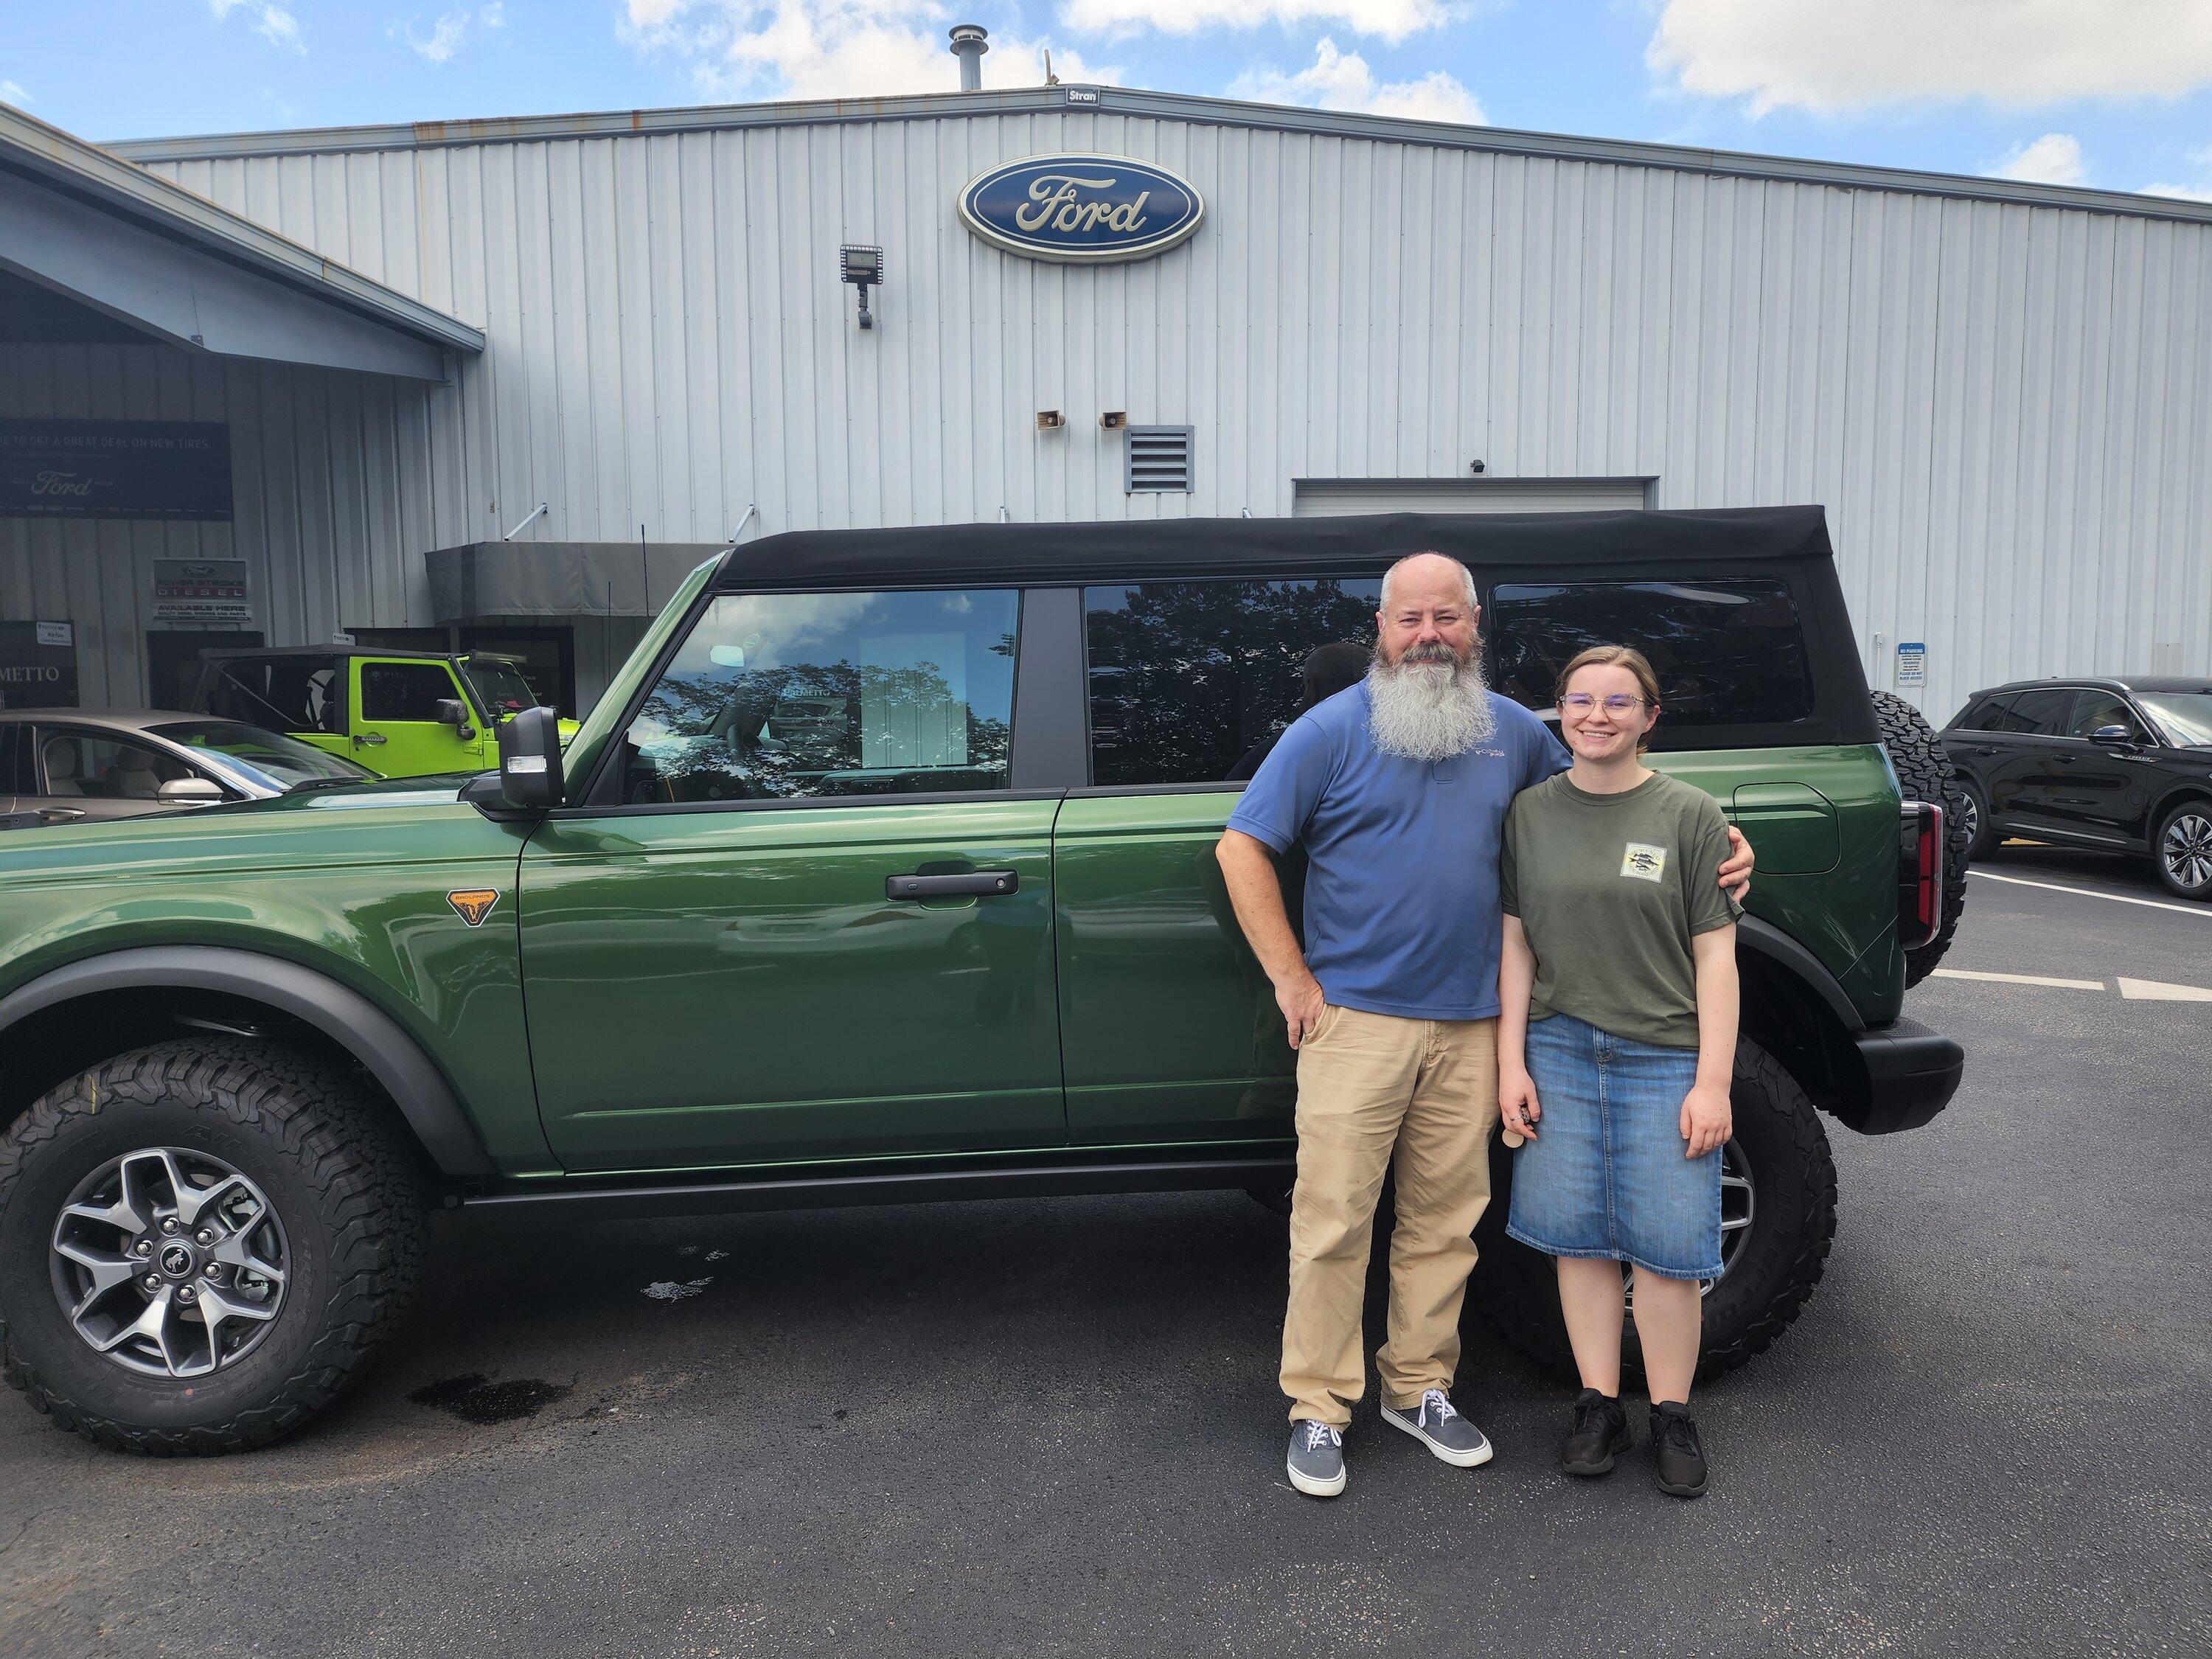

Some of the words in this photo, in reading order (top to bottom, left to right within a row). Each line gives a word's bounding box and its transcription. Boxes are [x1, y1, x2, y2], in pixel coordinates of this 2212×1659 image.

[1069, 90, 1096, 101] Stran
[1015, 175, 1151, 233] Ford
[14, 437, 27, 446] TO
[30, 437, 50, 446] GET
[54, 437, 62, 446] A
[64, 437, 97, 447] GREAT
[102, 437, 128, 448] DEAL
[132, 438, 147, 448] ON
[151, 439, 175, 448] NEW
[31, 470, 93, 495] Ford
